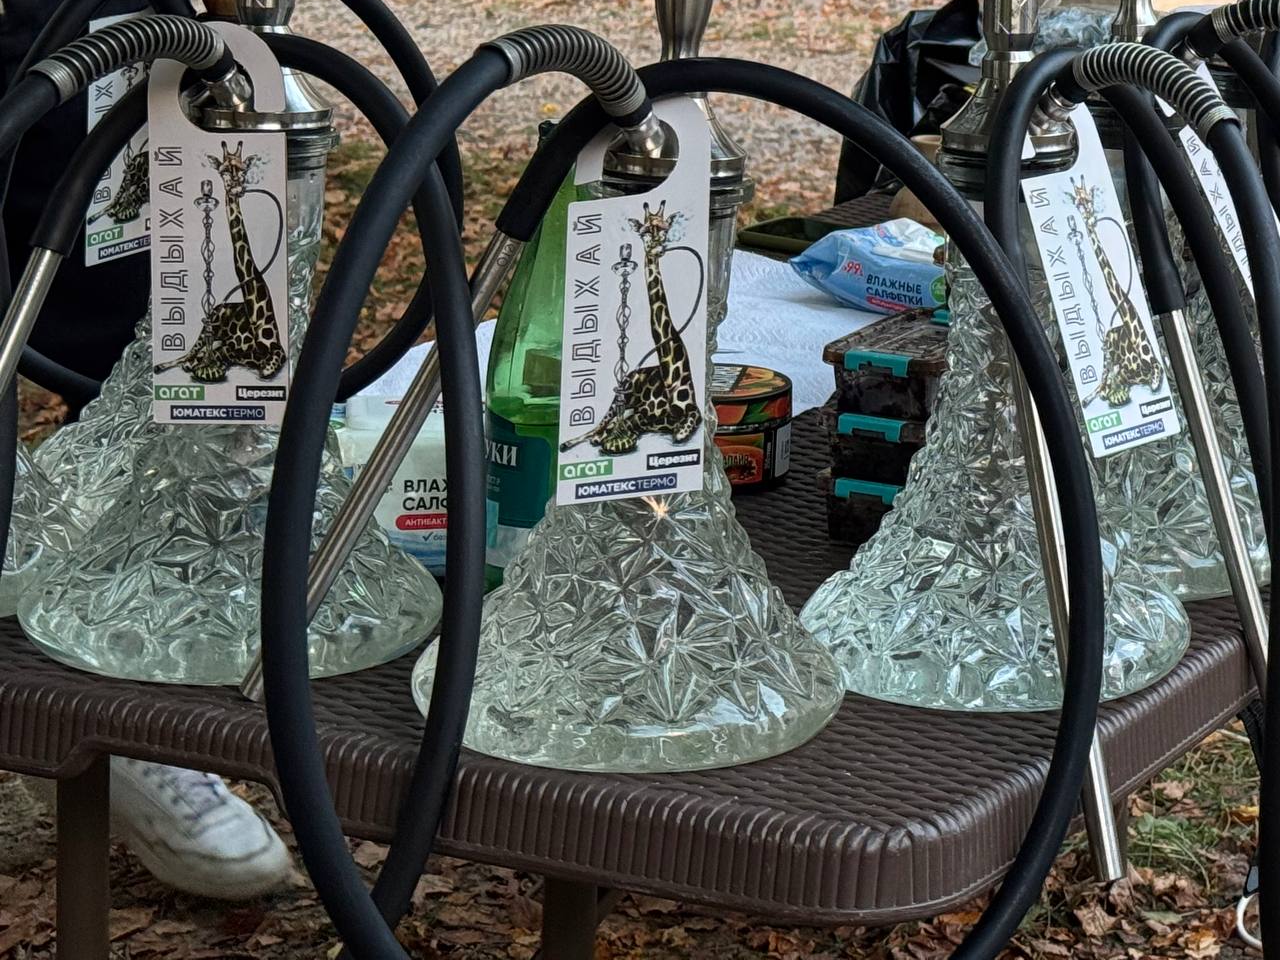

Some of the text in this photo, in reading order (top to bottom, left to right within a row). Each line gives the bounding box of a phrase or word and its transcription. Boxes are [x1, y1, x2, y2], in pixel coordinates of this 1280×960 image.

[154, 147, 188, 351] ВЫДЫХАЙ
[866, 273, 922, 295] ВЛАЖНЫЕ
[1029, 187, 1098, 385] ВЫДЫХАЙ
[866, 286, 923, 306] САЛФЕТКИ
[569, 213, 602, 426] ВЫДЫХАЙ
[238, 388, 284, 399] Церезит
[649, 453, 698, 467] Церезит
